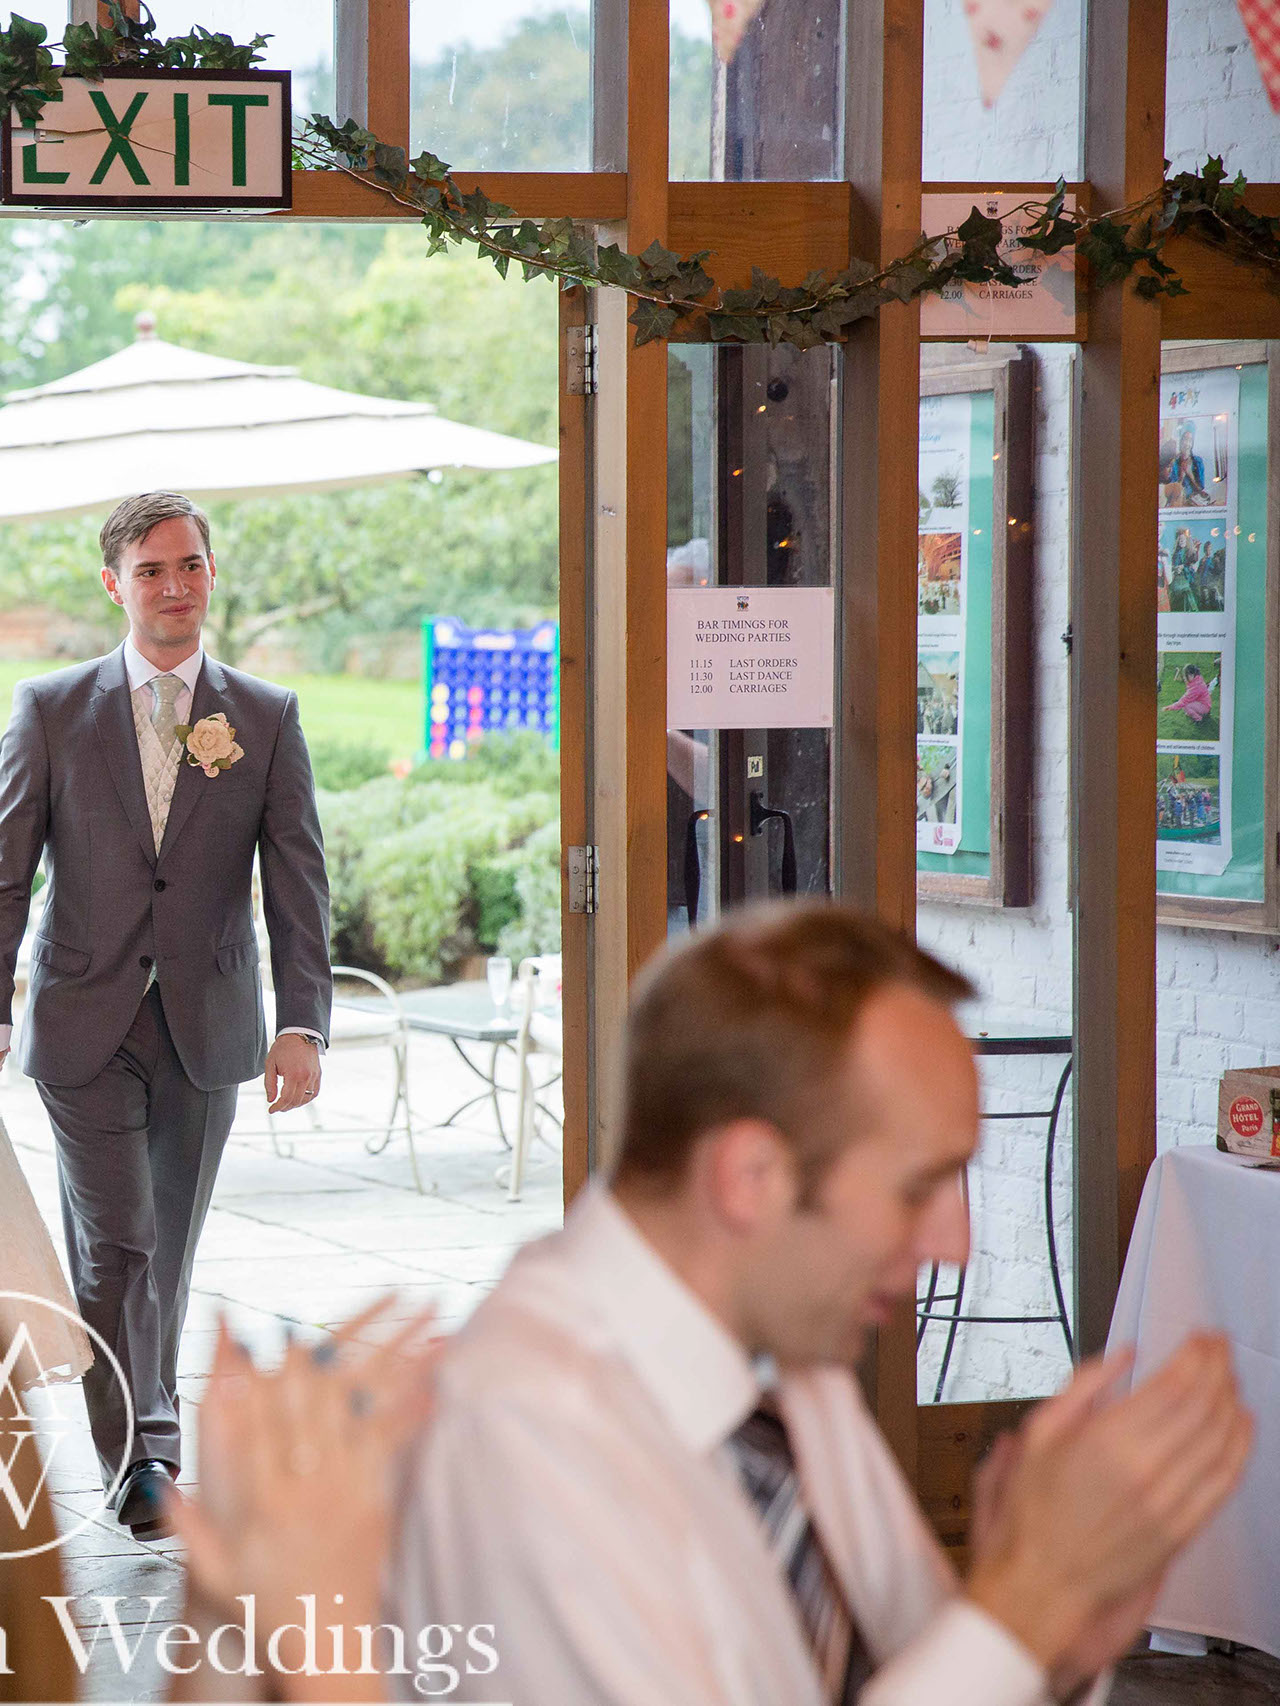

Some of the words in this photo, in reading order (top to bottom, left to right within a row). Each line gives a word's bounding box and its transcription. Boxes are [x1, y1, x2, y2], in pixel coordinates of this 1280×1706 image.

[979, 290, 1033, 299] CARRIAGES
[697, 620, 719, 629] BAR
[722, 620, 766, 629] TIMINGS
[768, 619, 789, 629] FOR
[695, 632, 745, 642] WEDDING
[748, 632, 791, 642] PARTIES
[690, 659, 713, 668] 11.15
[729, 659, 755, 668] LAST
[757, 659, 798, 668] ORDERS
[690, 672, 713, 681] 11.30
[729, 672, 755, 681] LAST
[757, 671, 792, 680] DANCE
[690, 684, 713, 694] 12.00
[729, 684, 787, 693] CARRIAGES
[1236, 1103, 1259, 1112] GRAND
[1241, 1124, 1259, 1133] Paris
